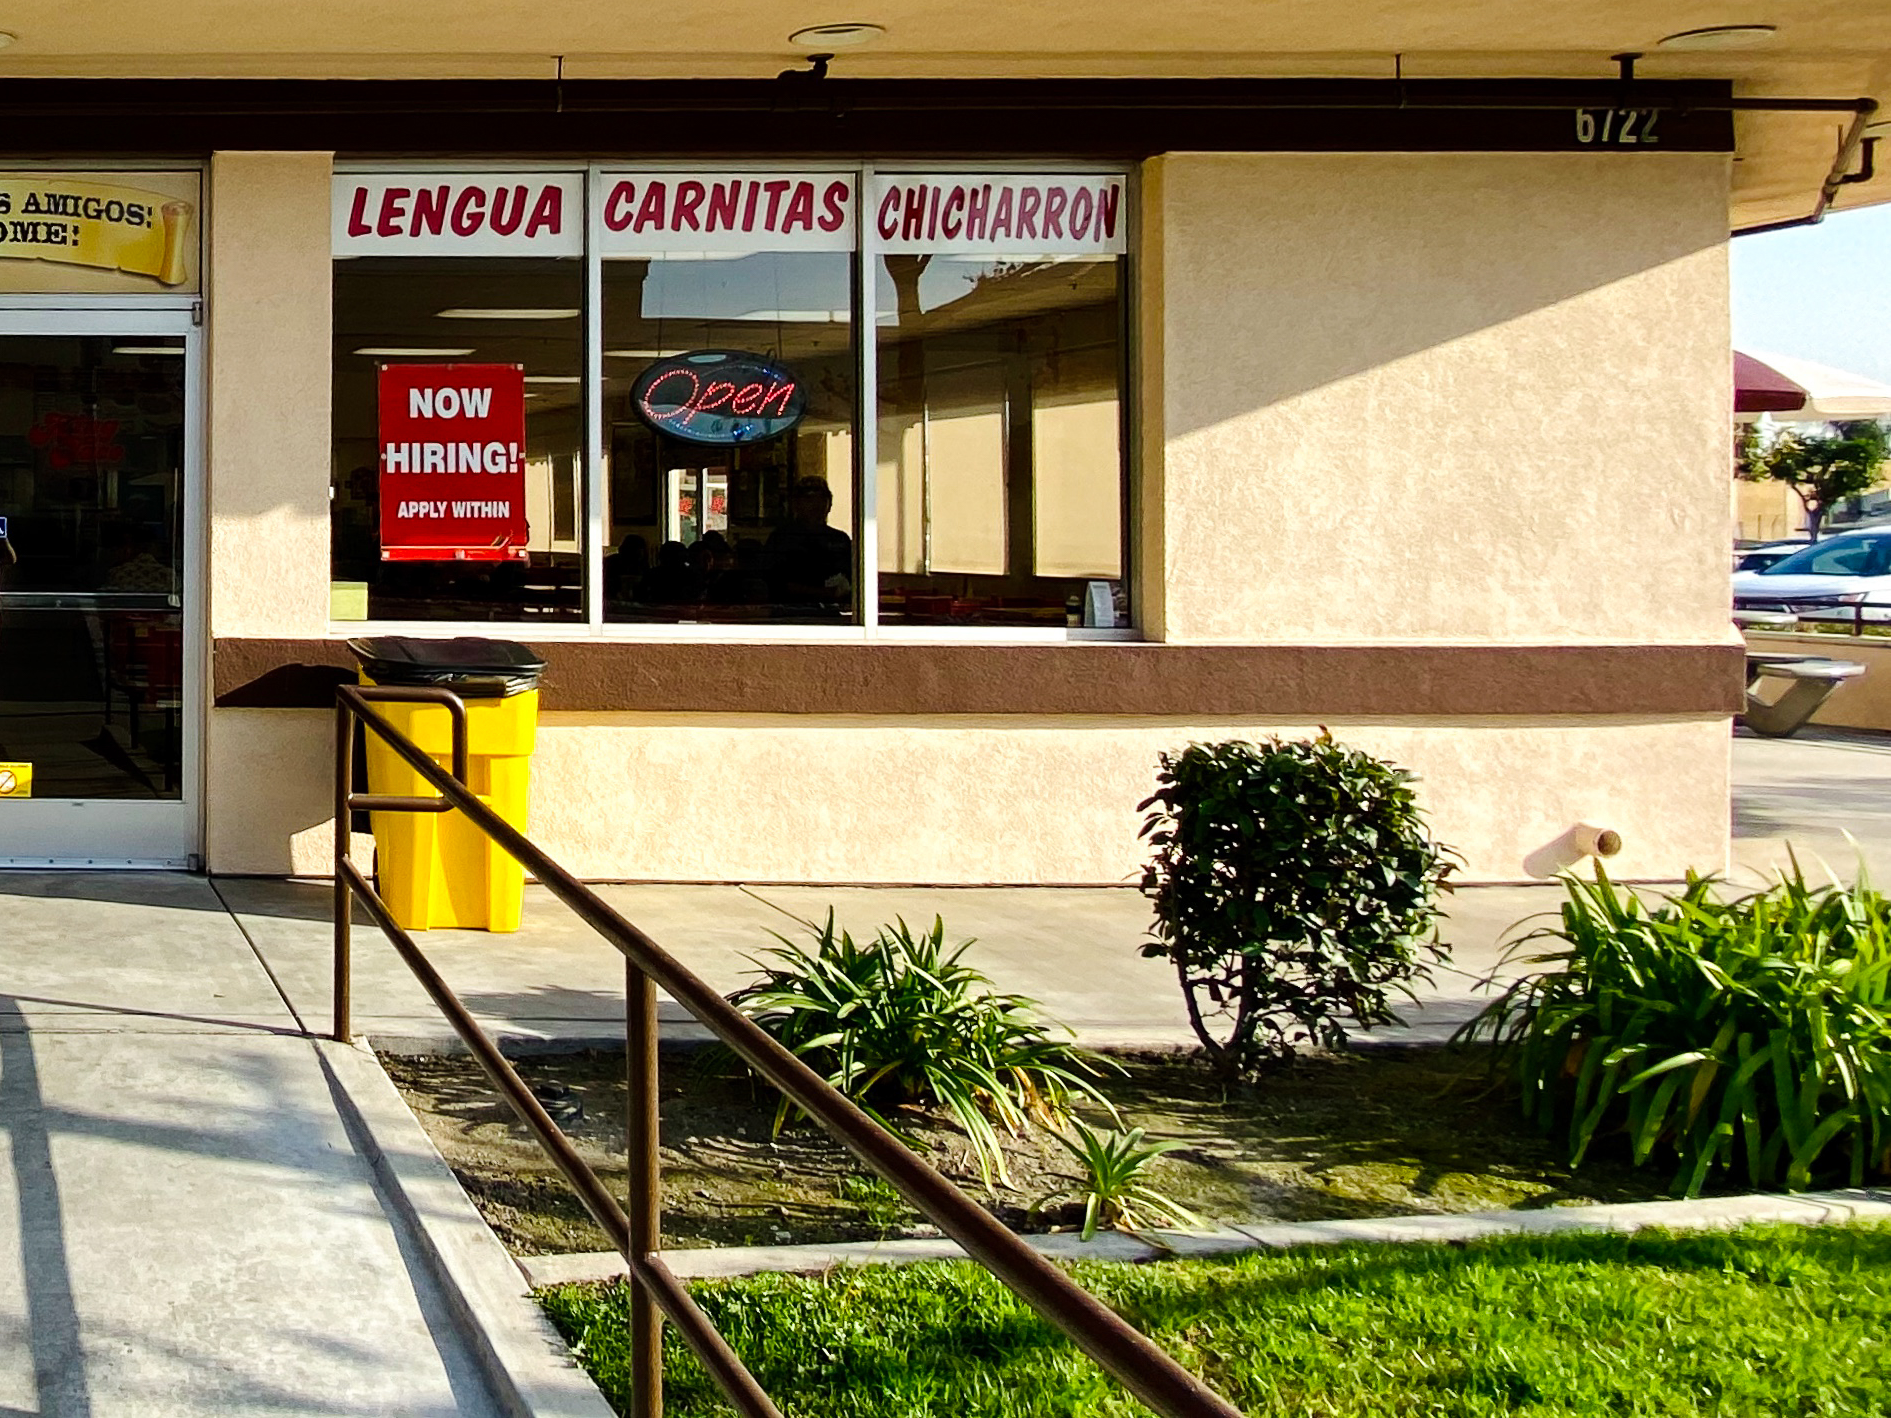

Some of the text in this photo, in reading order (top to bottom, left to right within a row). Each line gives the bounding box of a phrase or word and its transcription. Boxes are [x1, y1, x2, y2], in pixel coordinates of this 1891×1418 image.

[1576, 107, 1659, 143] 6722
[20, 192, 154, 229] AMIGOS!
[347, 185, 563, 239] LENGUA
[603, 179, 850, 235] CARNITAS
[877, 183, 1119, 242] CHICHARRON
[409, 387, 492, 419] NOW
[644, 368, 796, 425] Open
[386, 442, 518, 474] HIRING!
[397, 501, 510, 519] APPLY WITHIN
